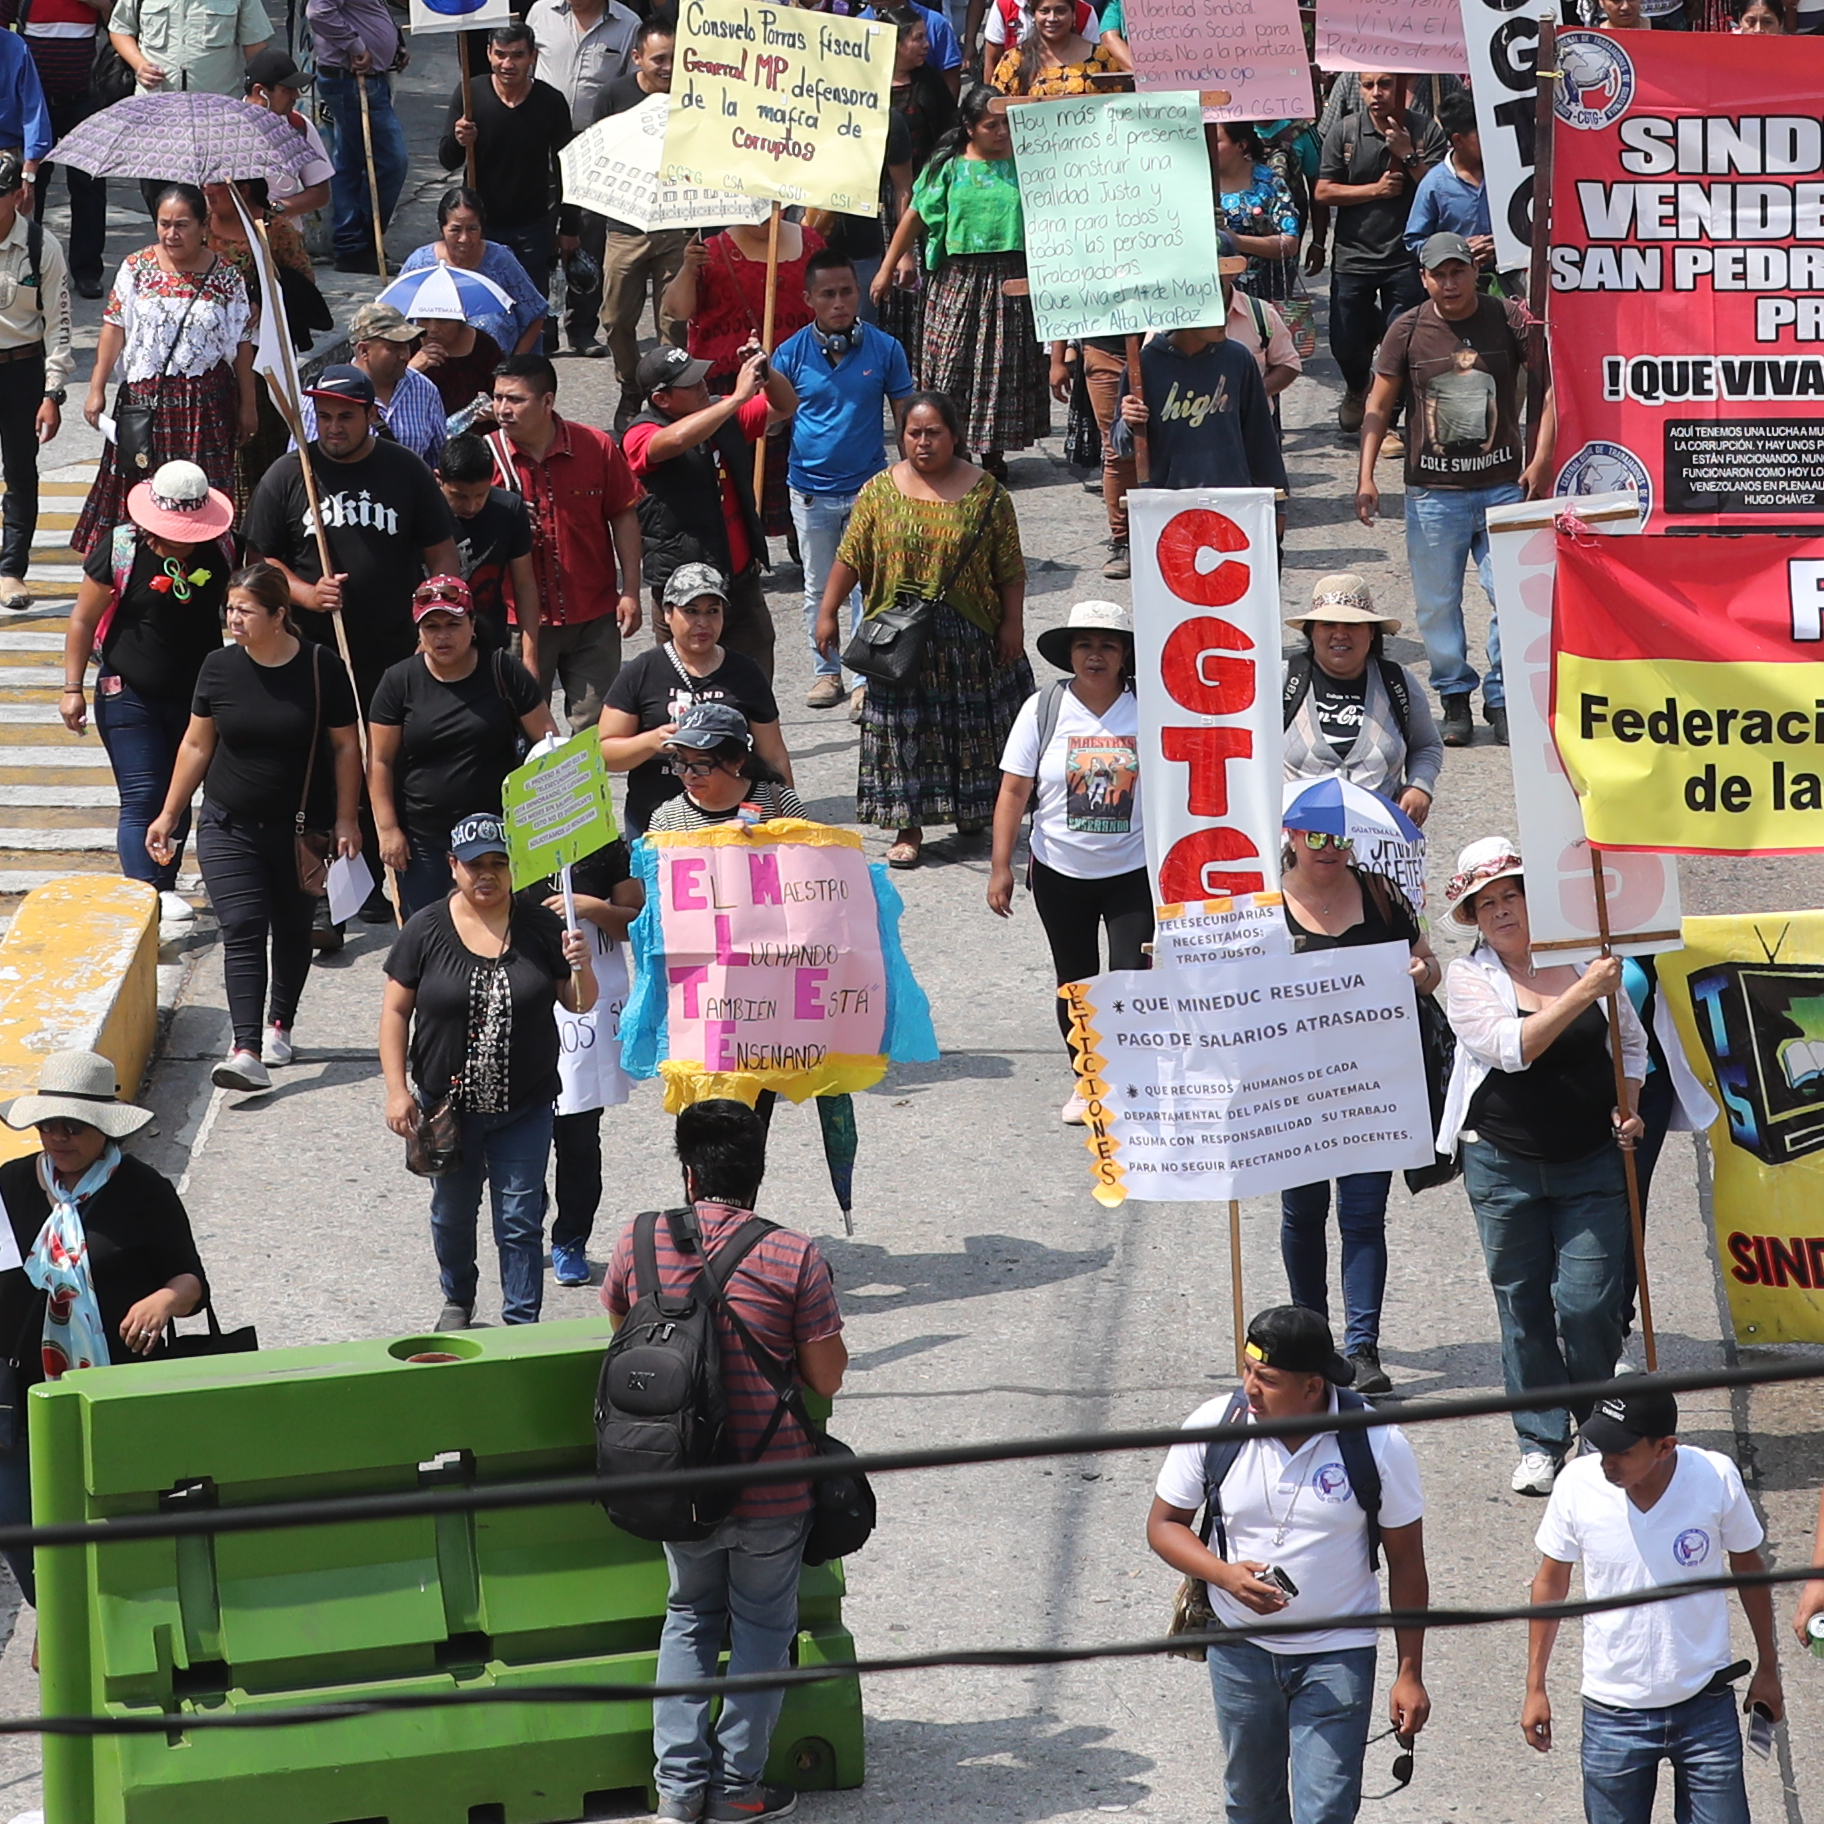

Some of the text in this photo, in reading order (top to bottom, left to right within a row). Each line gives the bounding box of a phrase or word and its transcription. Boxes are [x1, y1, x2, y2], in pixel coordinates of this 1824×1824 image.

[758, 9, 807, 51] Porras
[819, 24, 871, 63] fiscal
[683, 47, 748, 82] General
[791, 66, 878, 113] defensora
[681, 77, 862, 138] de la de
[732, 126, 816, 162] Corruptos
[1550, 246, 1662, 293] SAN
[1160, 374, 1230, 428] high
[1670, 425, 1694, 437] AQUÍ
[1695, 426, 1742, 437] TENEMOS
[1744, 426, 1765, 437] UNA
[1674, 440, 1687, 451] LA
[1765, 440, 1786, 450] HAY
[1786, 439, 1816, 450] UNOS
[1420, 445, 1513, 473] COLE SWINDELL
[1682, 467, 1754, 478] FUNCIONARON
[1755, 467, 1786, 478] COMO
[1787, 466, 1809, 477] HOY
[1692, 452, 1724, 465] ESTÁN
[1689, 480, 1762, 492] VENEZOLANOS
[1763, 480, 1778, 491] EN
[1744, 492, 1816, 505] HUGO CHÁVEZ
[1156, 508, 1264, 900] CGTG
[1684, 760, 1753, 814] de
[1771, 757, 1822, 812] la
[671, 853, 850, 912] EL MAESTRO
[714, 914, 839, 968] LUCHANDO
[1157, 907, 1275, 933] TELESECUNDARIAS
[1172, 927, 1265, 947] NECESITAMOS:
[1176, 945, 1266, 964] TRATO JUSTO,
[670, 965, 777, 1020] TAMBIÉN
[1132, 973, 1366, 1013] QUE MINEDUC RESUELVA
[1116, 1005, 1410, 1048] PAGO DE SALARIOS ATRASADOS.
[1144, 1060, 1359, 1097] QUE RECURSOS HUMANOS DE CADA
[1124, 1080, 1382, 1122] DEPARTAMENTAL DEL PAÍS DE GUATEMALA
[1128, 1102, 1398, 1147] ASUMA CON RESPONSABILIDAD SU TRABAJO
[1128, 1128, 1414, 1173] PARA NO SEGUIR AFECTANDO LOS DOCENTES.
